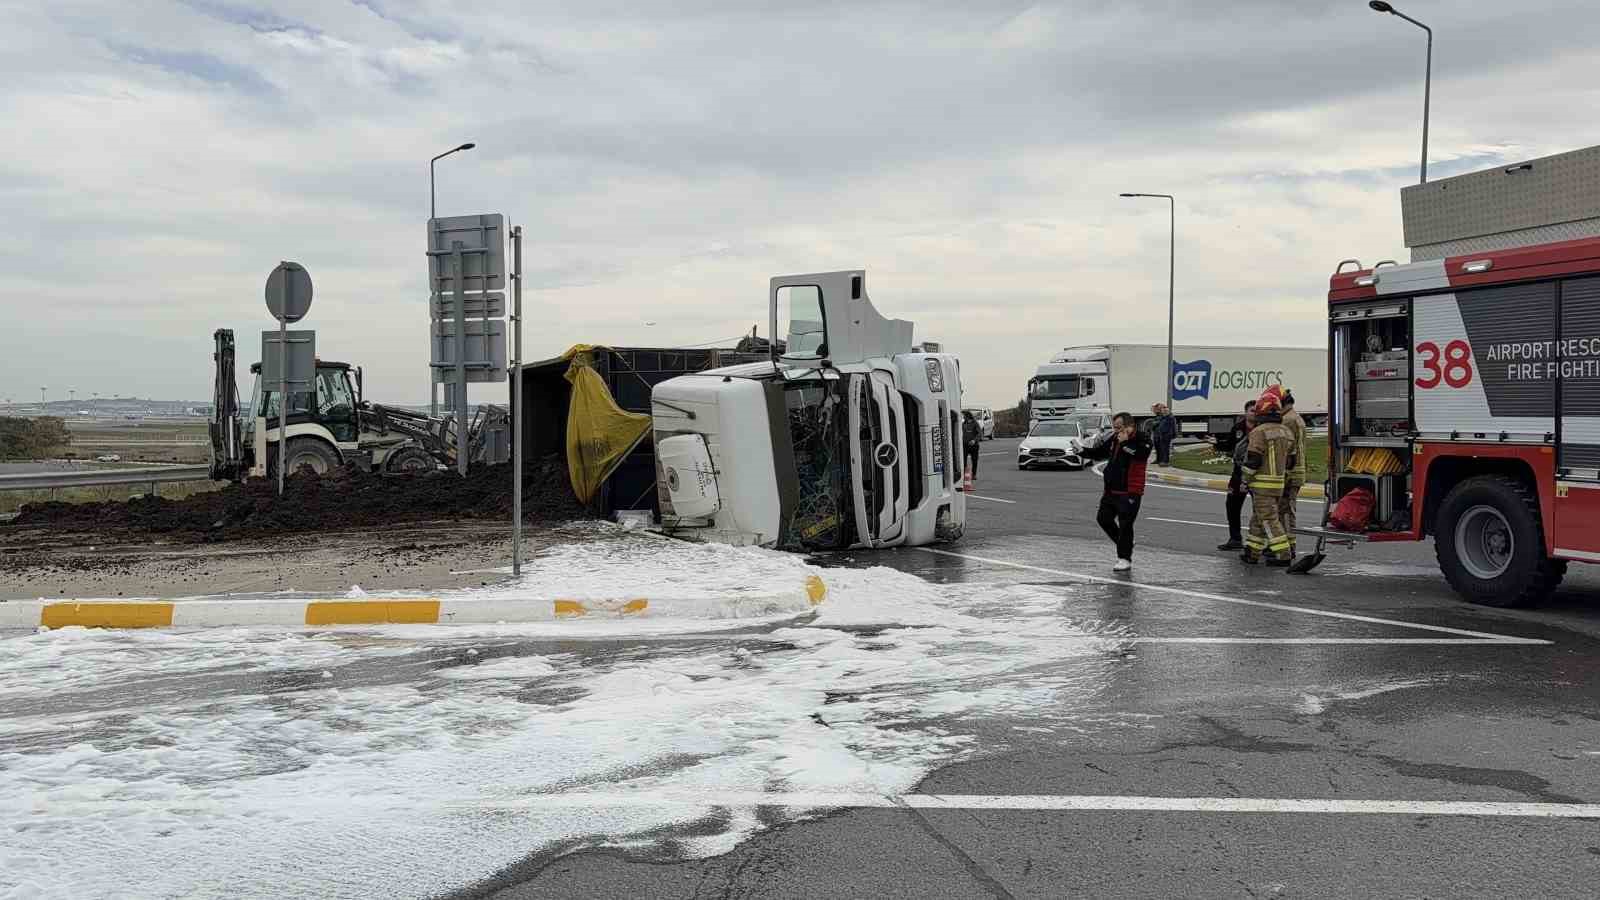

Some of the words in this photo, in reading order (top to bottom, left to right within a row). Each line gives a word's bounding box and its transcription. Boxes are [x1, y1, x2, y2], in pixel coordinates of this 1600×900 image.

[1487, 341, 1553, 361] AIRPORT
[1556, 338, 1600, 358] RESC
[1415, 340, 1472, 389] 38
[1507, 362, 1542, 380] FIRE
[1547, 359, 1600, 378] FIGHTI
[1173, 370, 1207, 391] OZT
[1213, 370, 1283, 390] LOGISTICS
